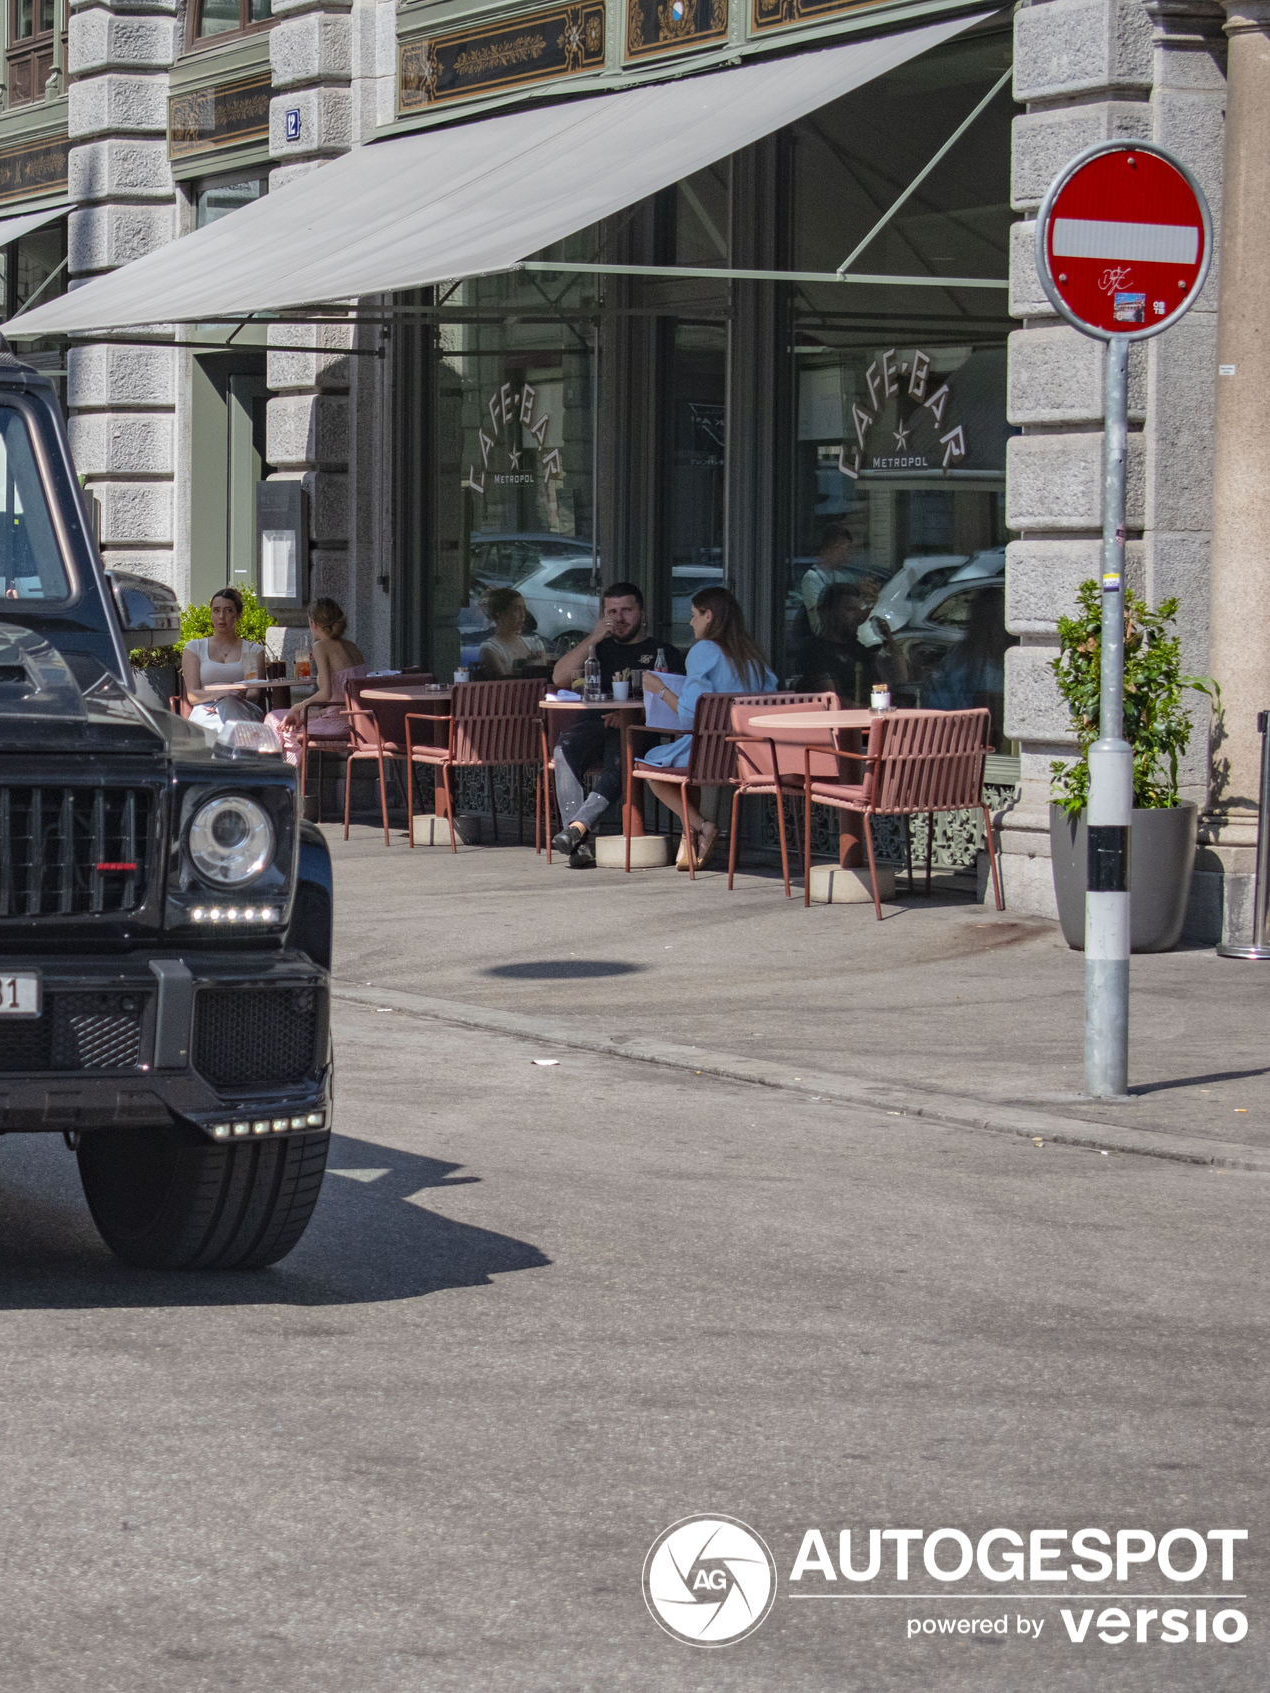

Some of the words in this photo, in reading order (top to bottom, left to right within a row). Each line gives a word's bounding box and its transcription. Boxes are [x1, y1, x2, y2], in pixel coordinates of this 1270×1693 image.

[287, 114, 296, 136] 12
[872, 457, 929, 468] METROPOL
[494, 474, 535, 484] METROPOL
